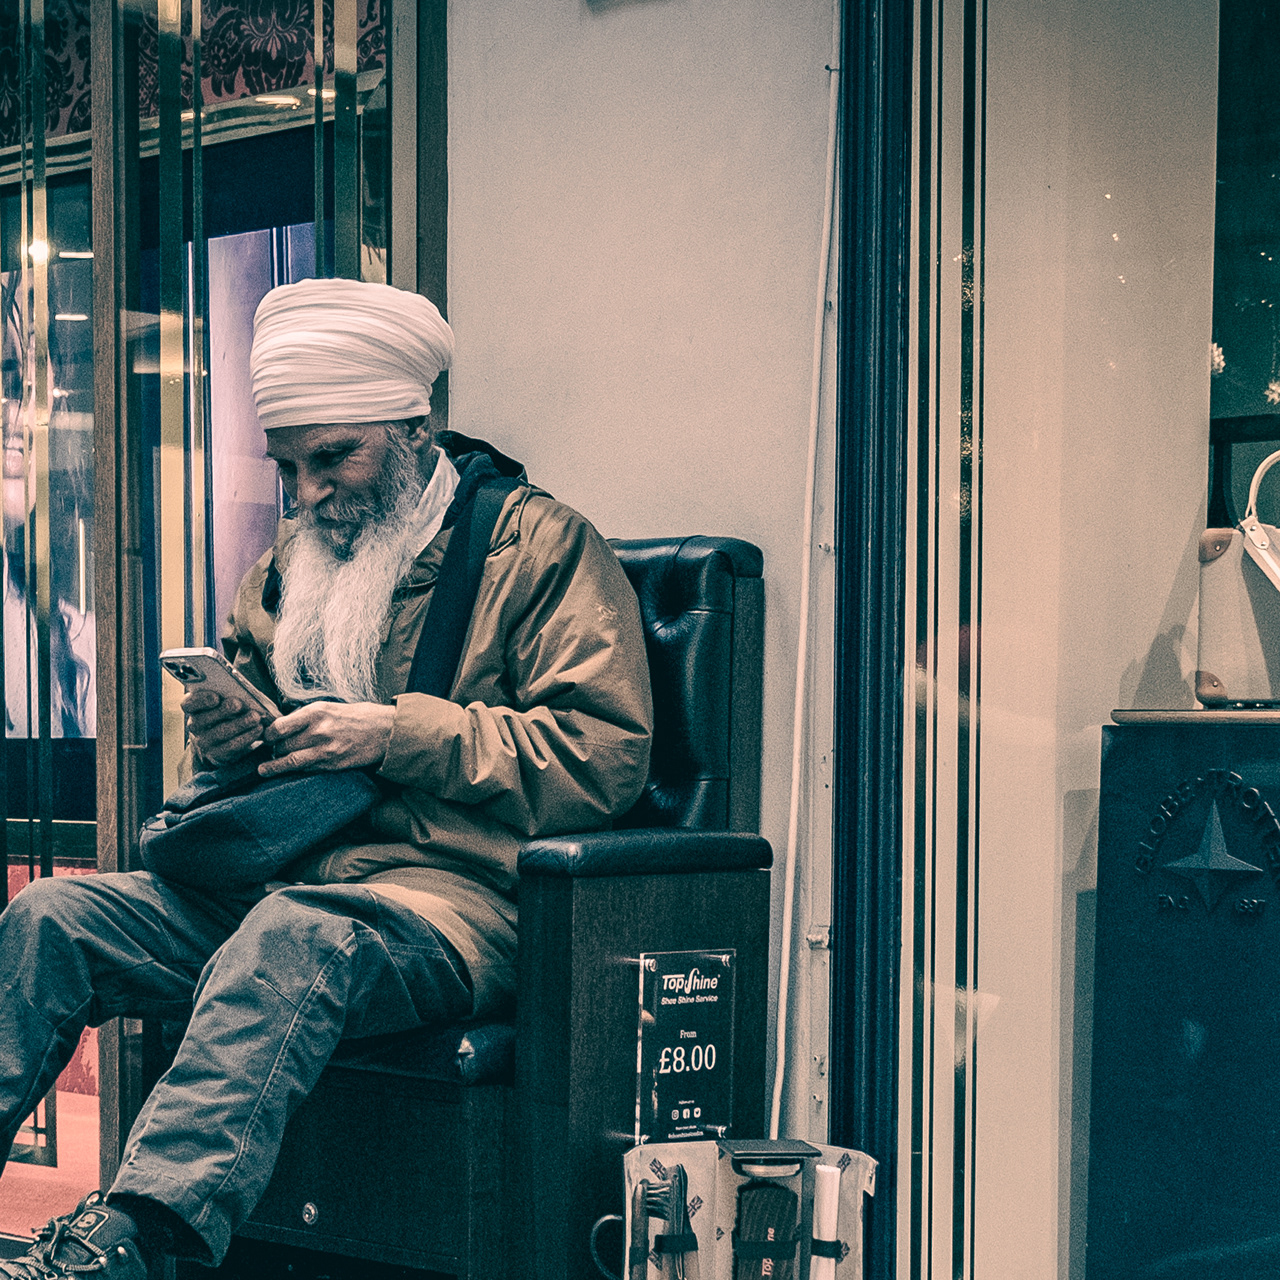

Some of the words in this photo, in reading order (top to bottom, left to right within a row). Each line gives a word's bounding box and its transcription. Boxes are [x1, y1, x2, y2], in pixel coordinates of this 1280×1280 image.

[696, 995, 718, 1003] Service
[679, 1029, 697, 1039] From
[659, 1044, 716, 1073] £8.00
